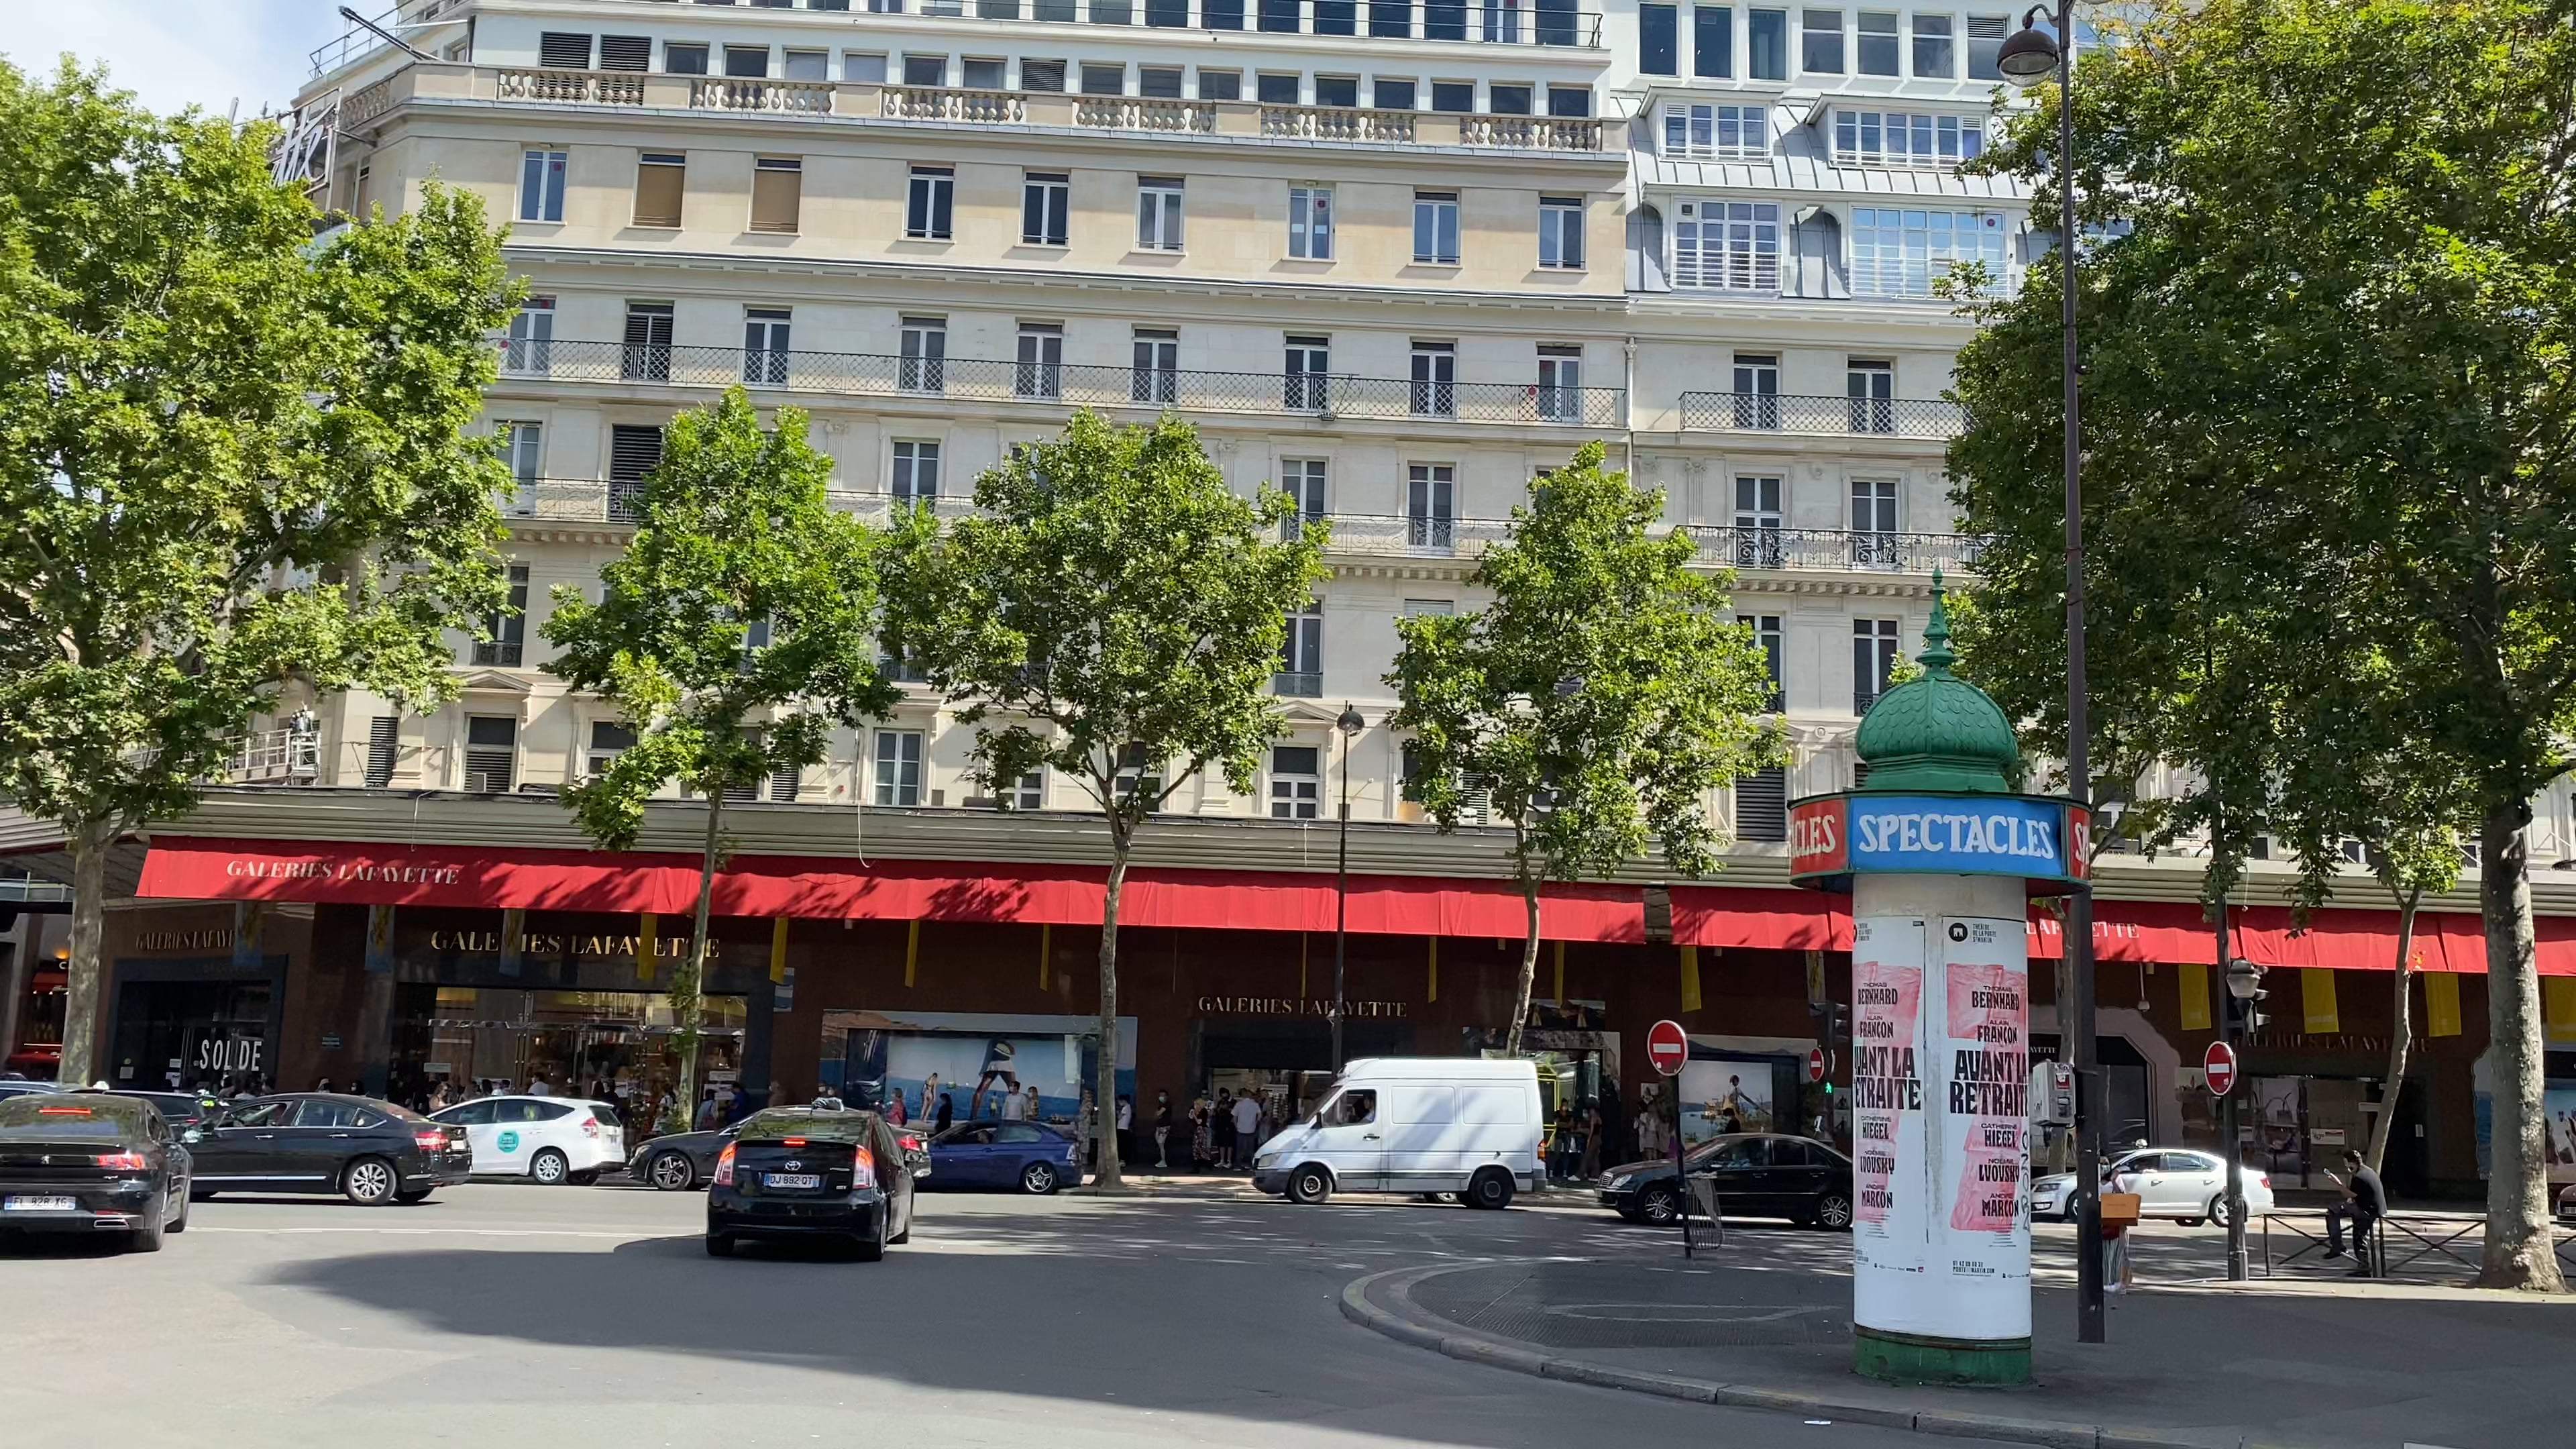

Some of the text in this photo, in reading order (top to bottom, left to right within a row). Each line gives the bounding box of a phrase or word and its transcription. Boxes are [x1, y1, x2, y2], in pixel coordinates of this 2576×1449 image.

[1859, 813, 2055, 860] SPECTACLES
[227, 861, 460, 885] GALERIES LAFAYETTE
[192, 928, 235, 949] LAFAYE
[2026, 918, 2140, 938] LAFETTE
[431, 930, 720, 958] GALEIES LAFAETE
[1198, 996, 1407, 1018] GALERIES LAFYETTE
[1858, 988, 1898, 1005] BERNHARD
[1972, 991, 2019, 1011] BERNHARD
[200, 1039, 262, 1071] SOLDE
[1892, 1047, 1916, 1078] LA
[1955, 1049, 2012, 1083] AVANT
[1856, 1077, 1921, 1110] ETRAITE
[1862, 1122, 1889, 1139] HIEGEL
[1984, 1130, 2018, 1148] HIEGEL
[1862, 1190, 1893, 1209] MARCON
[1982, 1199, 2019, 1217] MARCON
